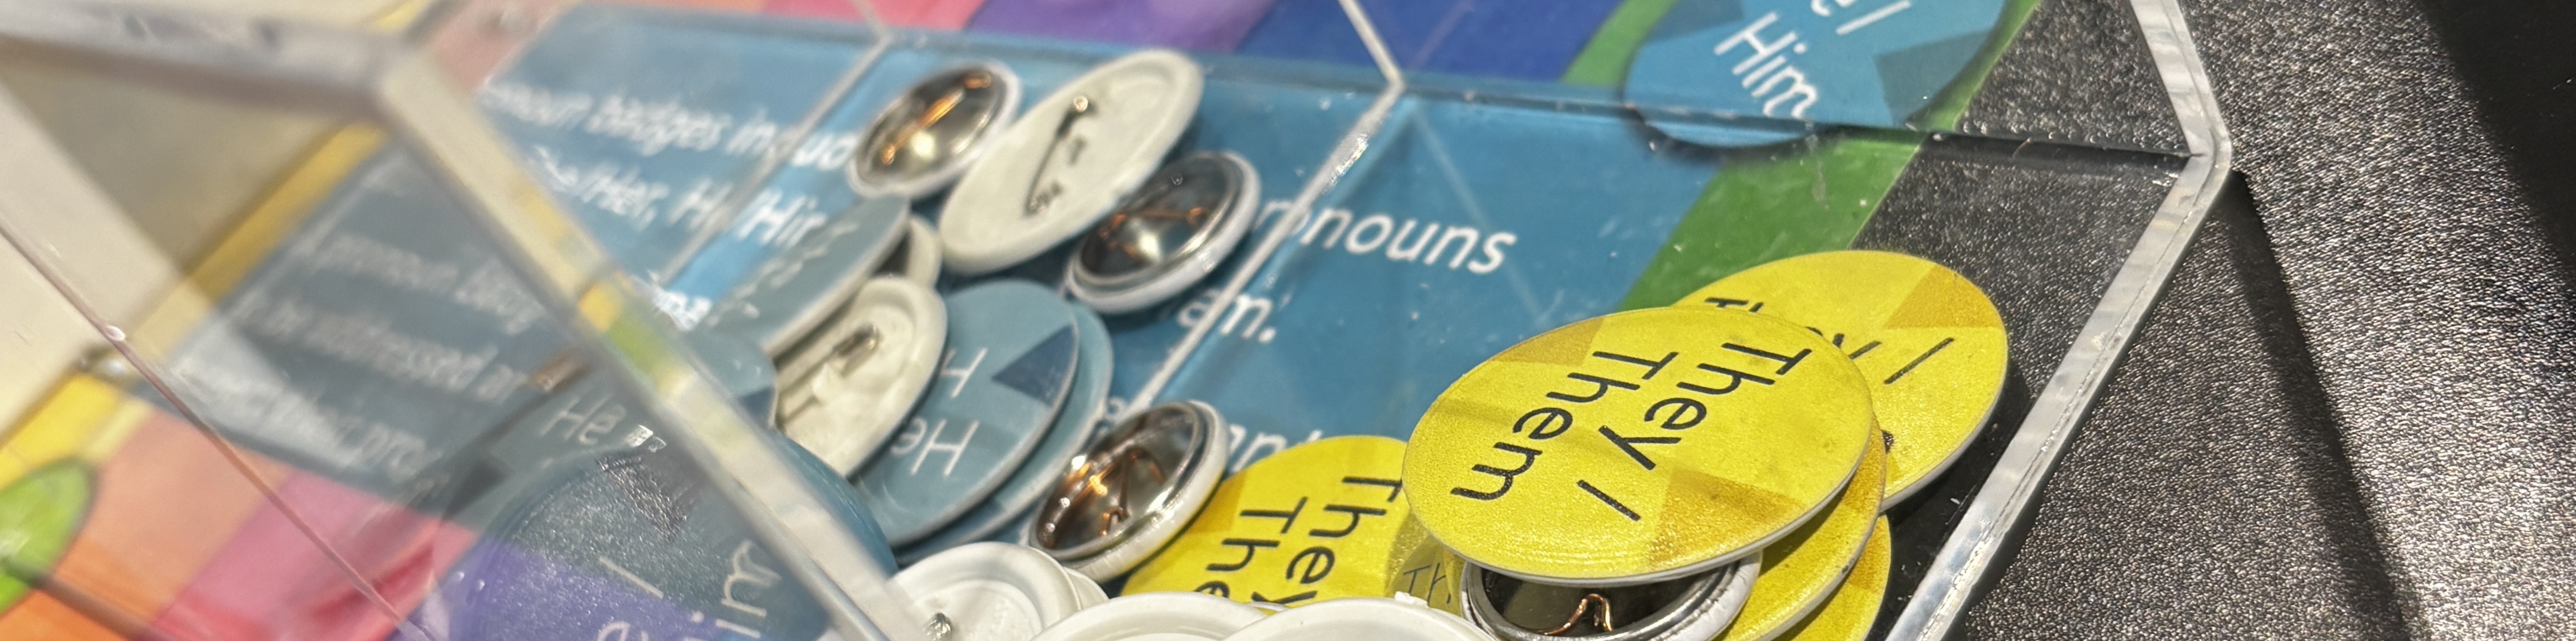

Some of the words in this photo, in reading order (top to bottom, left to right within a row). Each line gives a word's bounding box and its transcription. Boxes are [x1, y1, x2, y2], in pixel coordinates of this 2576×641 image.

[1714, 11, 1818, 120] Him
[1450, 350, 1679, 501] Them
[1598, 342, 1812, 471] They
